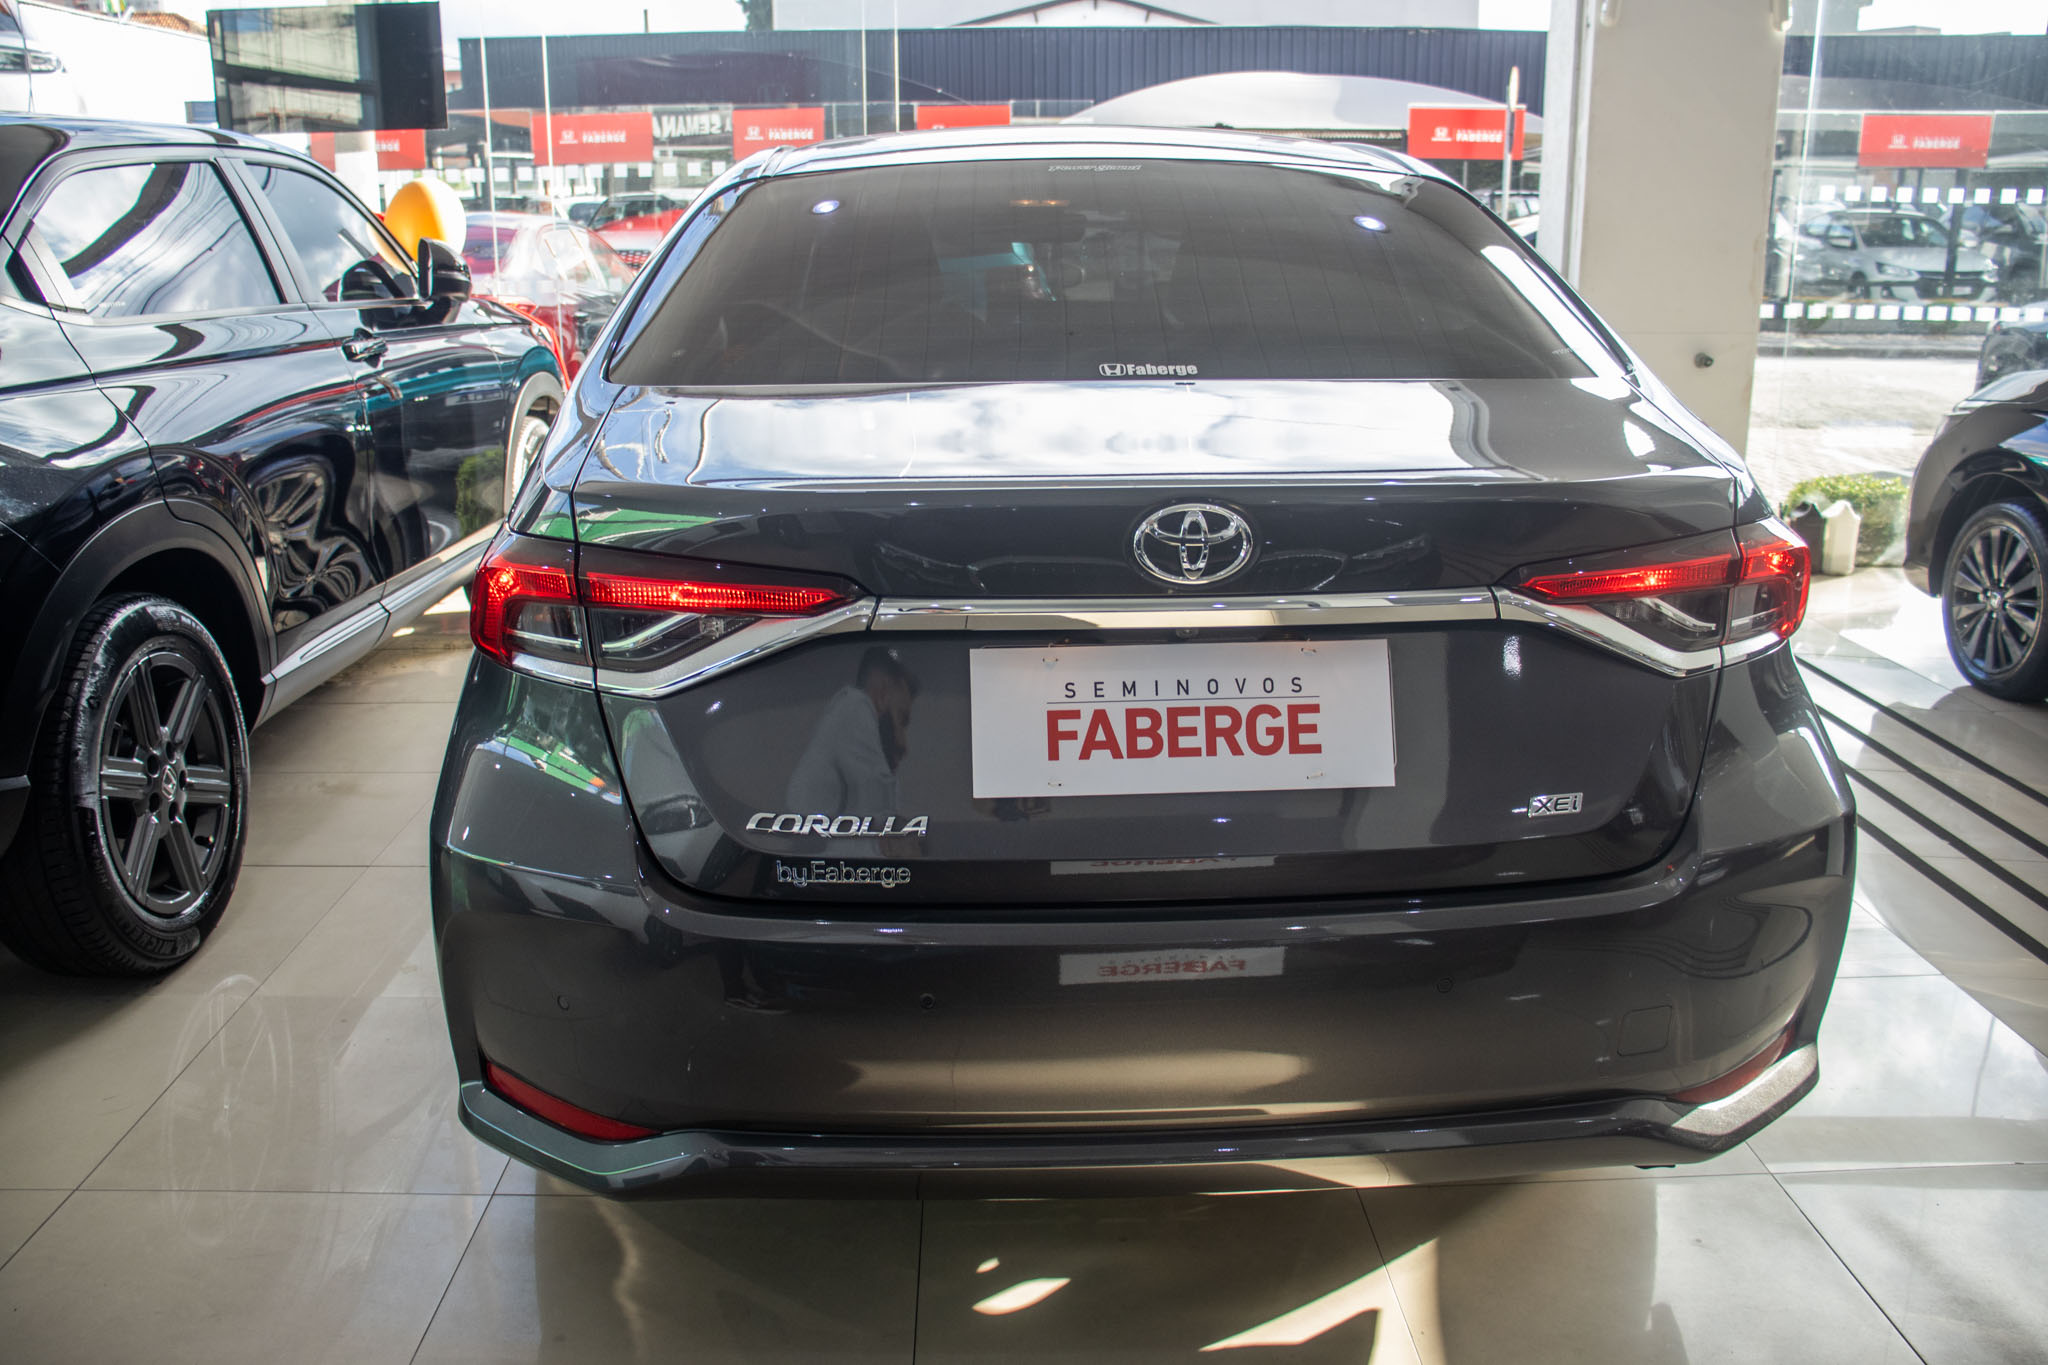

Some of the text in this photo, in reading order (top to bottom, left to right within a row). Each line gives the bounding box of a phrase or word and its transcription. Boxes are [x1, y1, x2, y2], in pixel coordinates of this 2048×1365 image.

[1126, 364, 1198, 376] Faberge
[1064, 677, 1304, 698] SEMINOVOS
[1046, 703, 1323, 761] FABERGE
[746, 812, 929, 838] COROLLA
